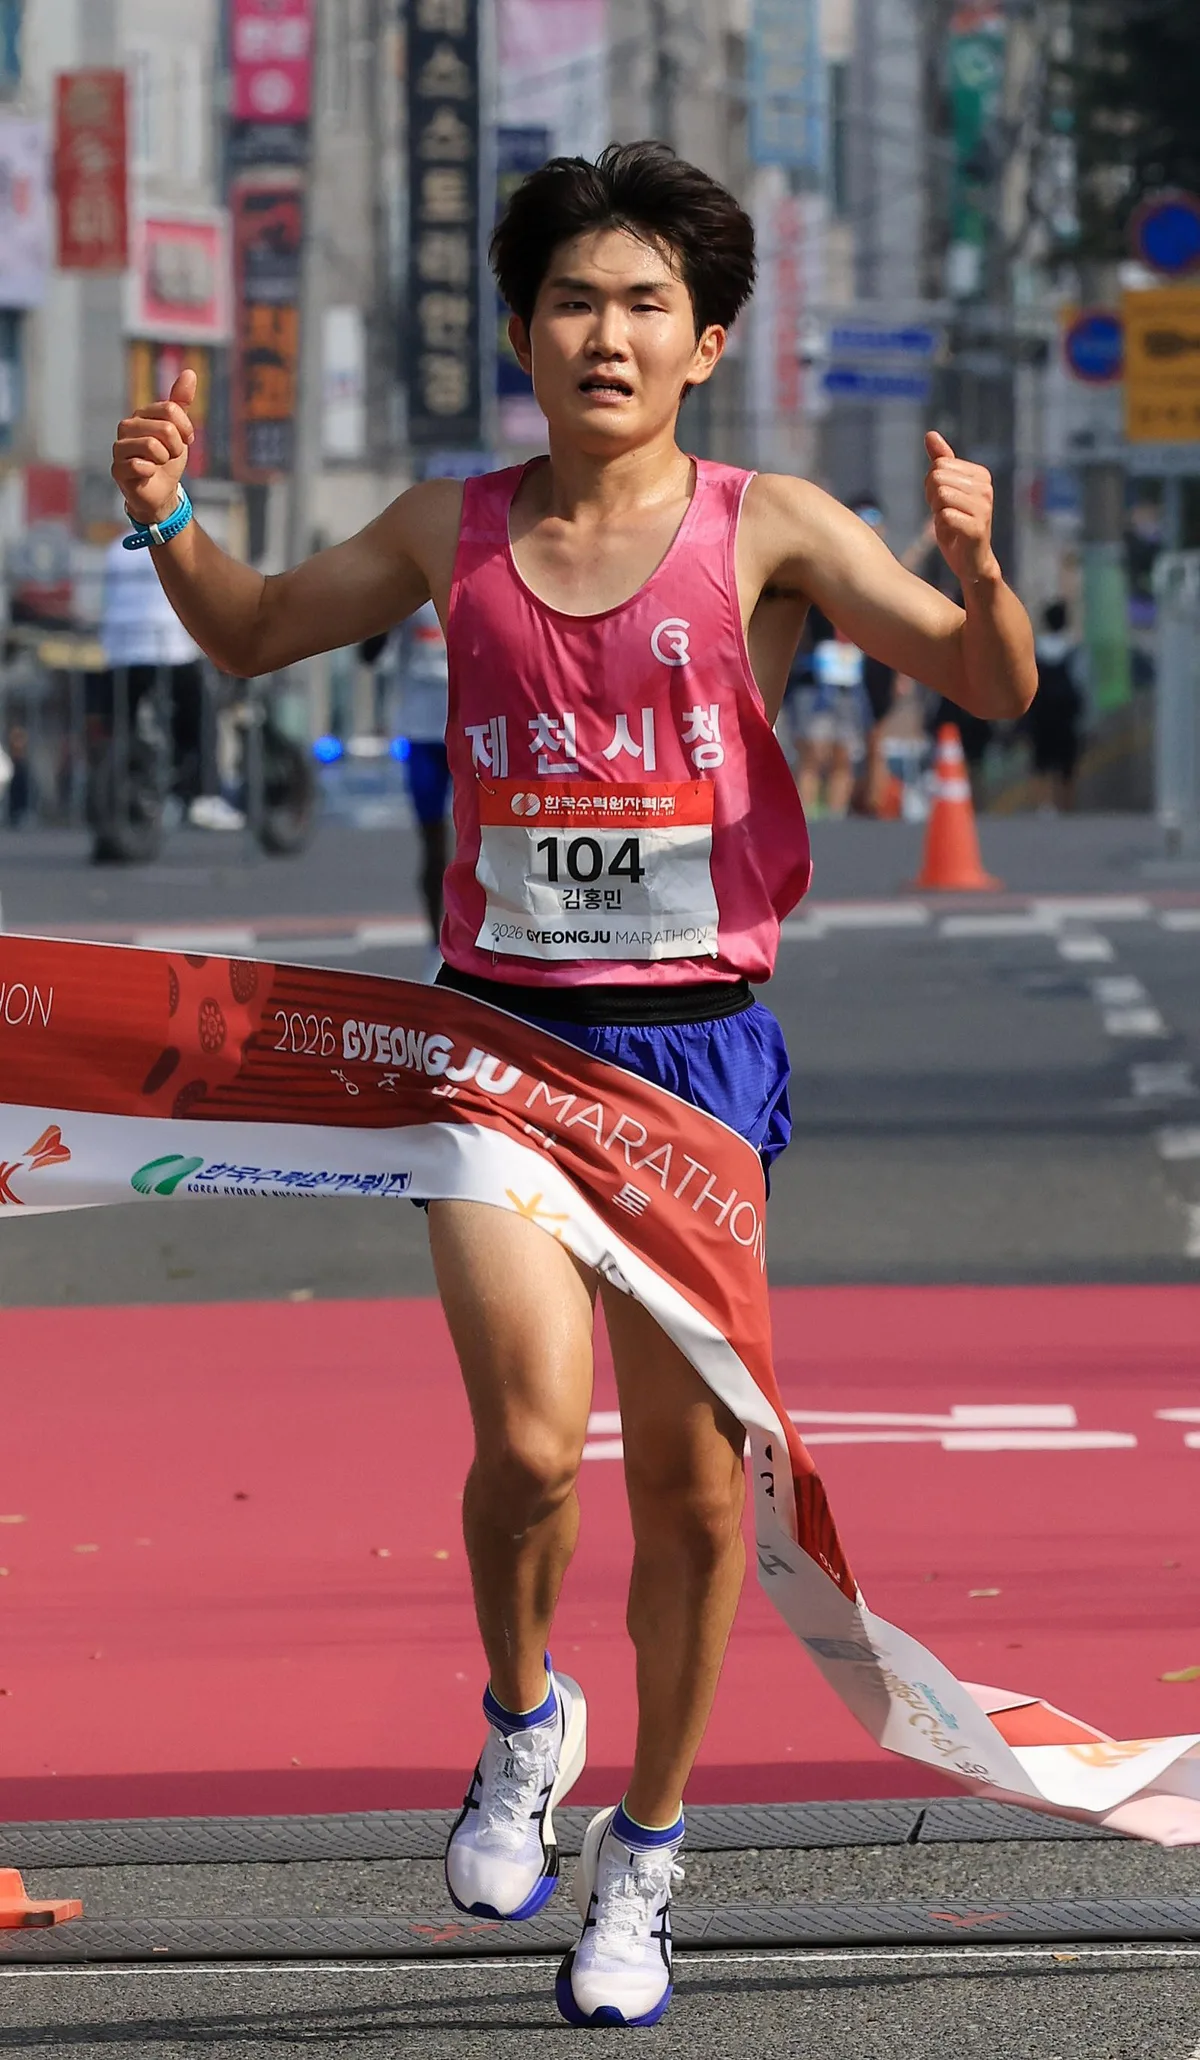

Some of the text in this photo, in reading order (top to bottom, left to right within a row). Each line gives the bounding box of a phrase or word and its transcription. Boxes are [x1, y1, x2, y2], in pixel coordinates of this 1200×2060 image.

[464, 703, 726, 778] 제천시청
[536, 836, 645, 883] 104
[562, 888, 622, 910] 김홍민
[491, 922, 708, 945] 2026 GYEONGJU MARATHON
[274, 1010, 336, 1057] 2026
[342, 1019, 522, 1094] GYEONGJU
[524, 1080, 766, 1274] MARATHON
[187, 1182, 219, 1194] KOREA
